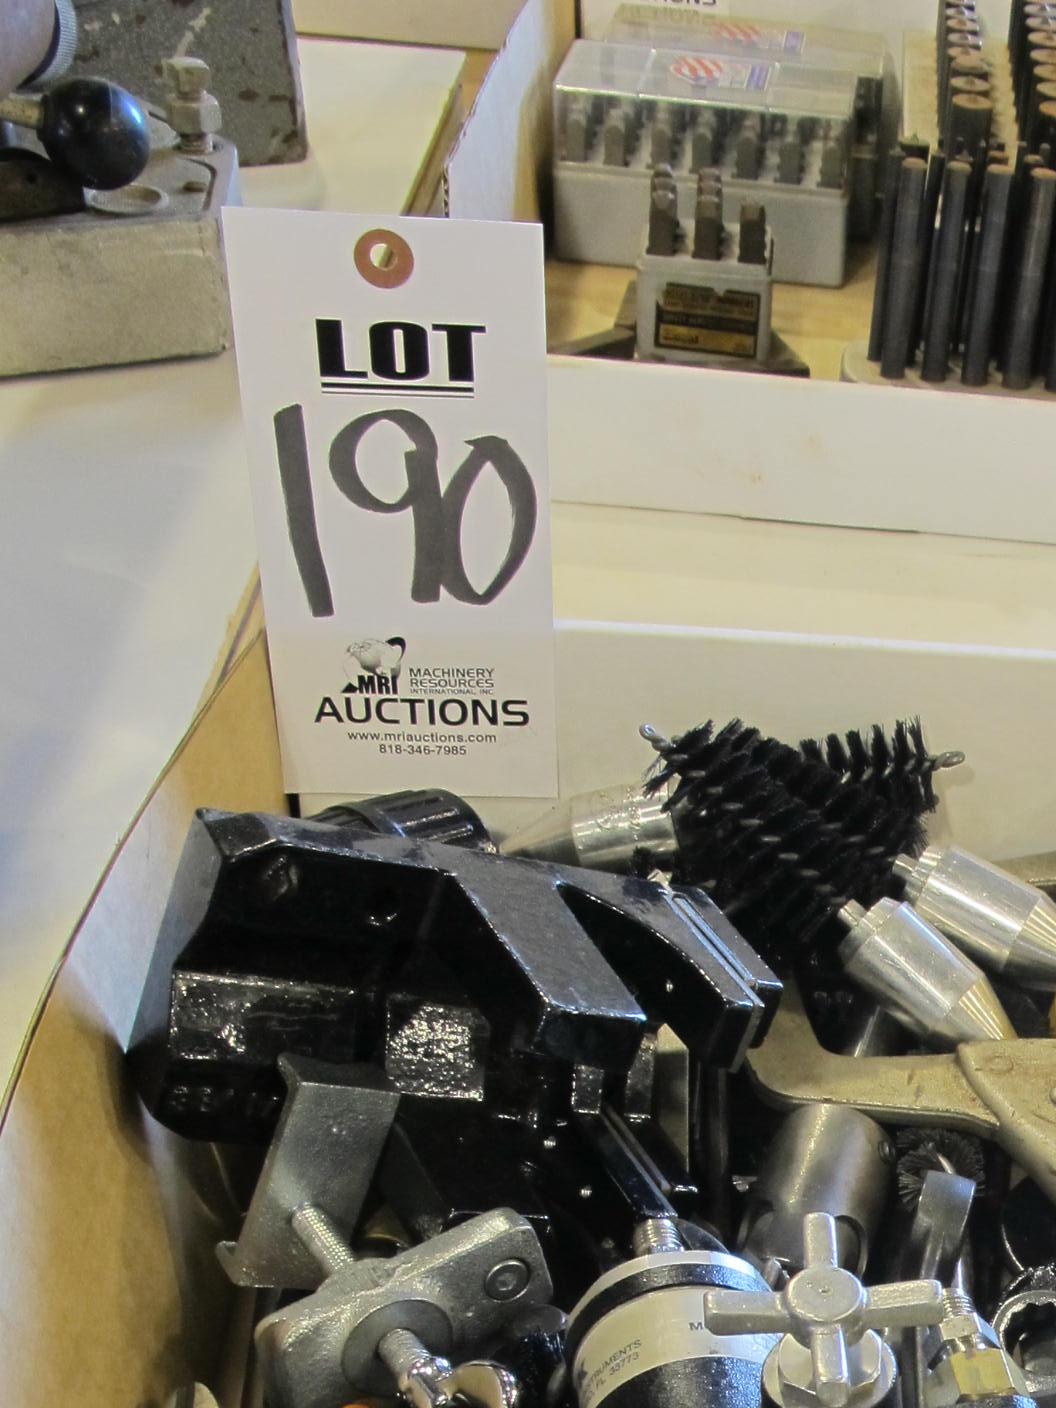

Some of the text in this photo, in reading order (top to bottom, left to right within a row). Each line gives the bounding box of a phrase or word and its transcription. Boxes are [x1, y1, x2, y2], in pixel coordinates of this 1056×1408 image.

[315, 318, 487, 382] LOT
[273, 403, 538, 618] 190
[408, 667, 496, 679] MACHINERY
[357, 674, 399, 695] MRI
[409, 678, 495, 689] RESOURCES
[314, 696, 530, 727] AUCTIONS
[347, 730, 497, 744] www.mriauctions.com
[379, 744, 467, 756] 818-346-7985
